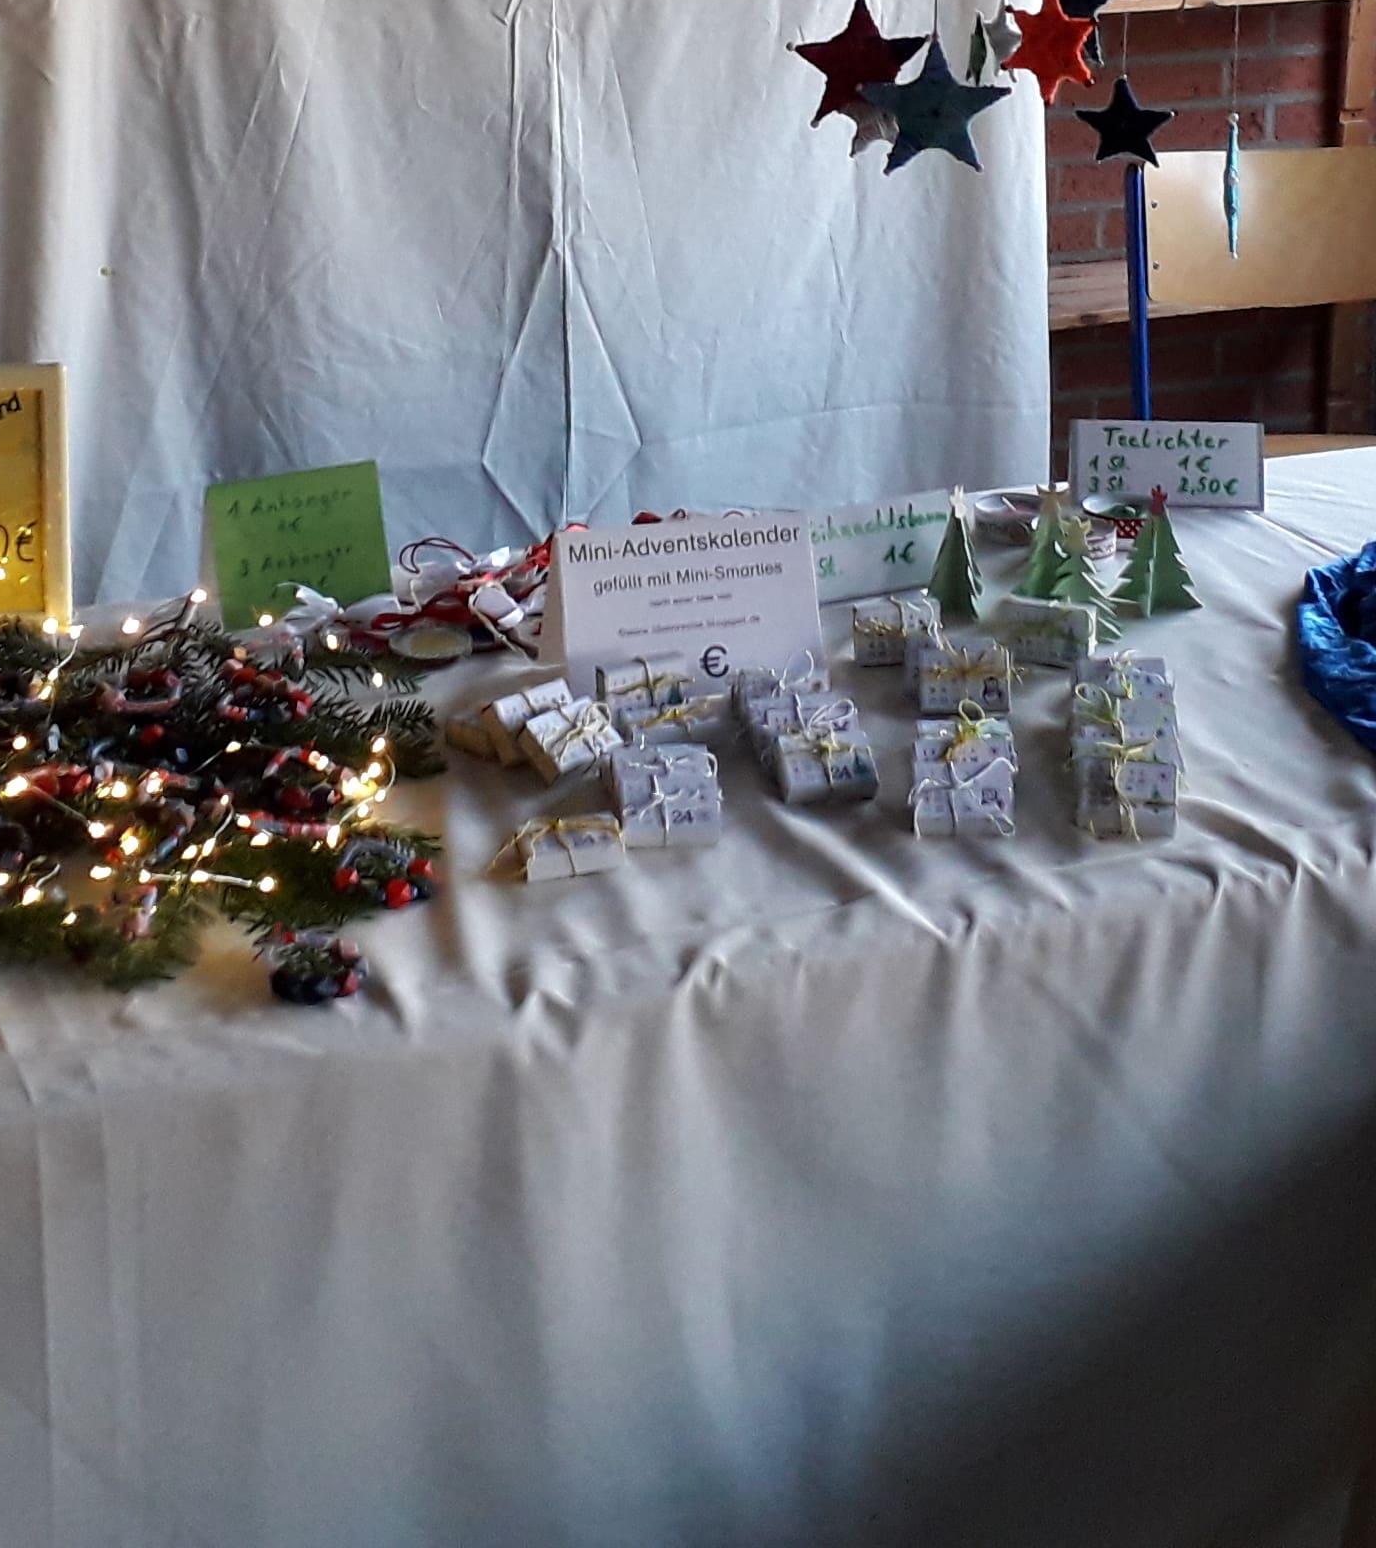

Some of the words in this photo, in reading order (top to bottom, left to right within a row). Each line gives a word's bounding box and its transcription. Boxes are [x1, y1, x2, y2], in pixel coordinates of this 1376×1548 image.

[1102, 426, 1232, 450] Teelichter
[1088, 455, 1099, 471] 1
[1088, 476, 1100, 493] 3
[1176, 476, 1239, 496] 2,50€
[568, 524, 801, 564] Mini-Adventskalender
[593, 573, 643, 596] gefüllt
[646, 570, 673, 588] mit
[675, 562, 784, 587] Mini-Smarties
[699, 644, 729, 678] €
